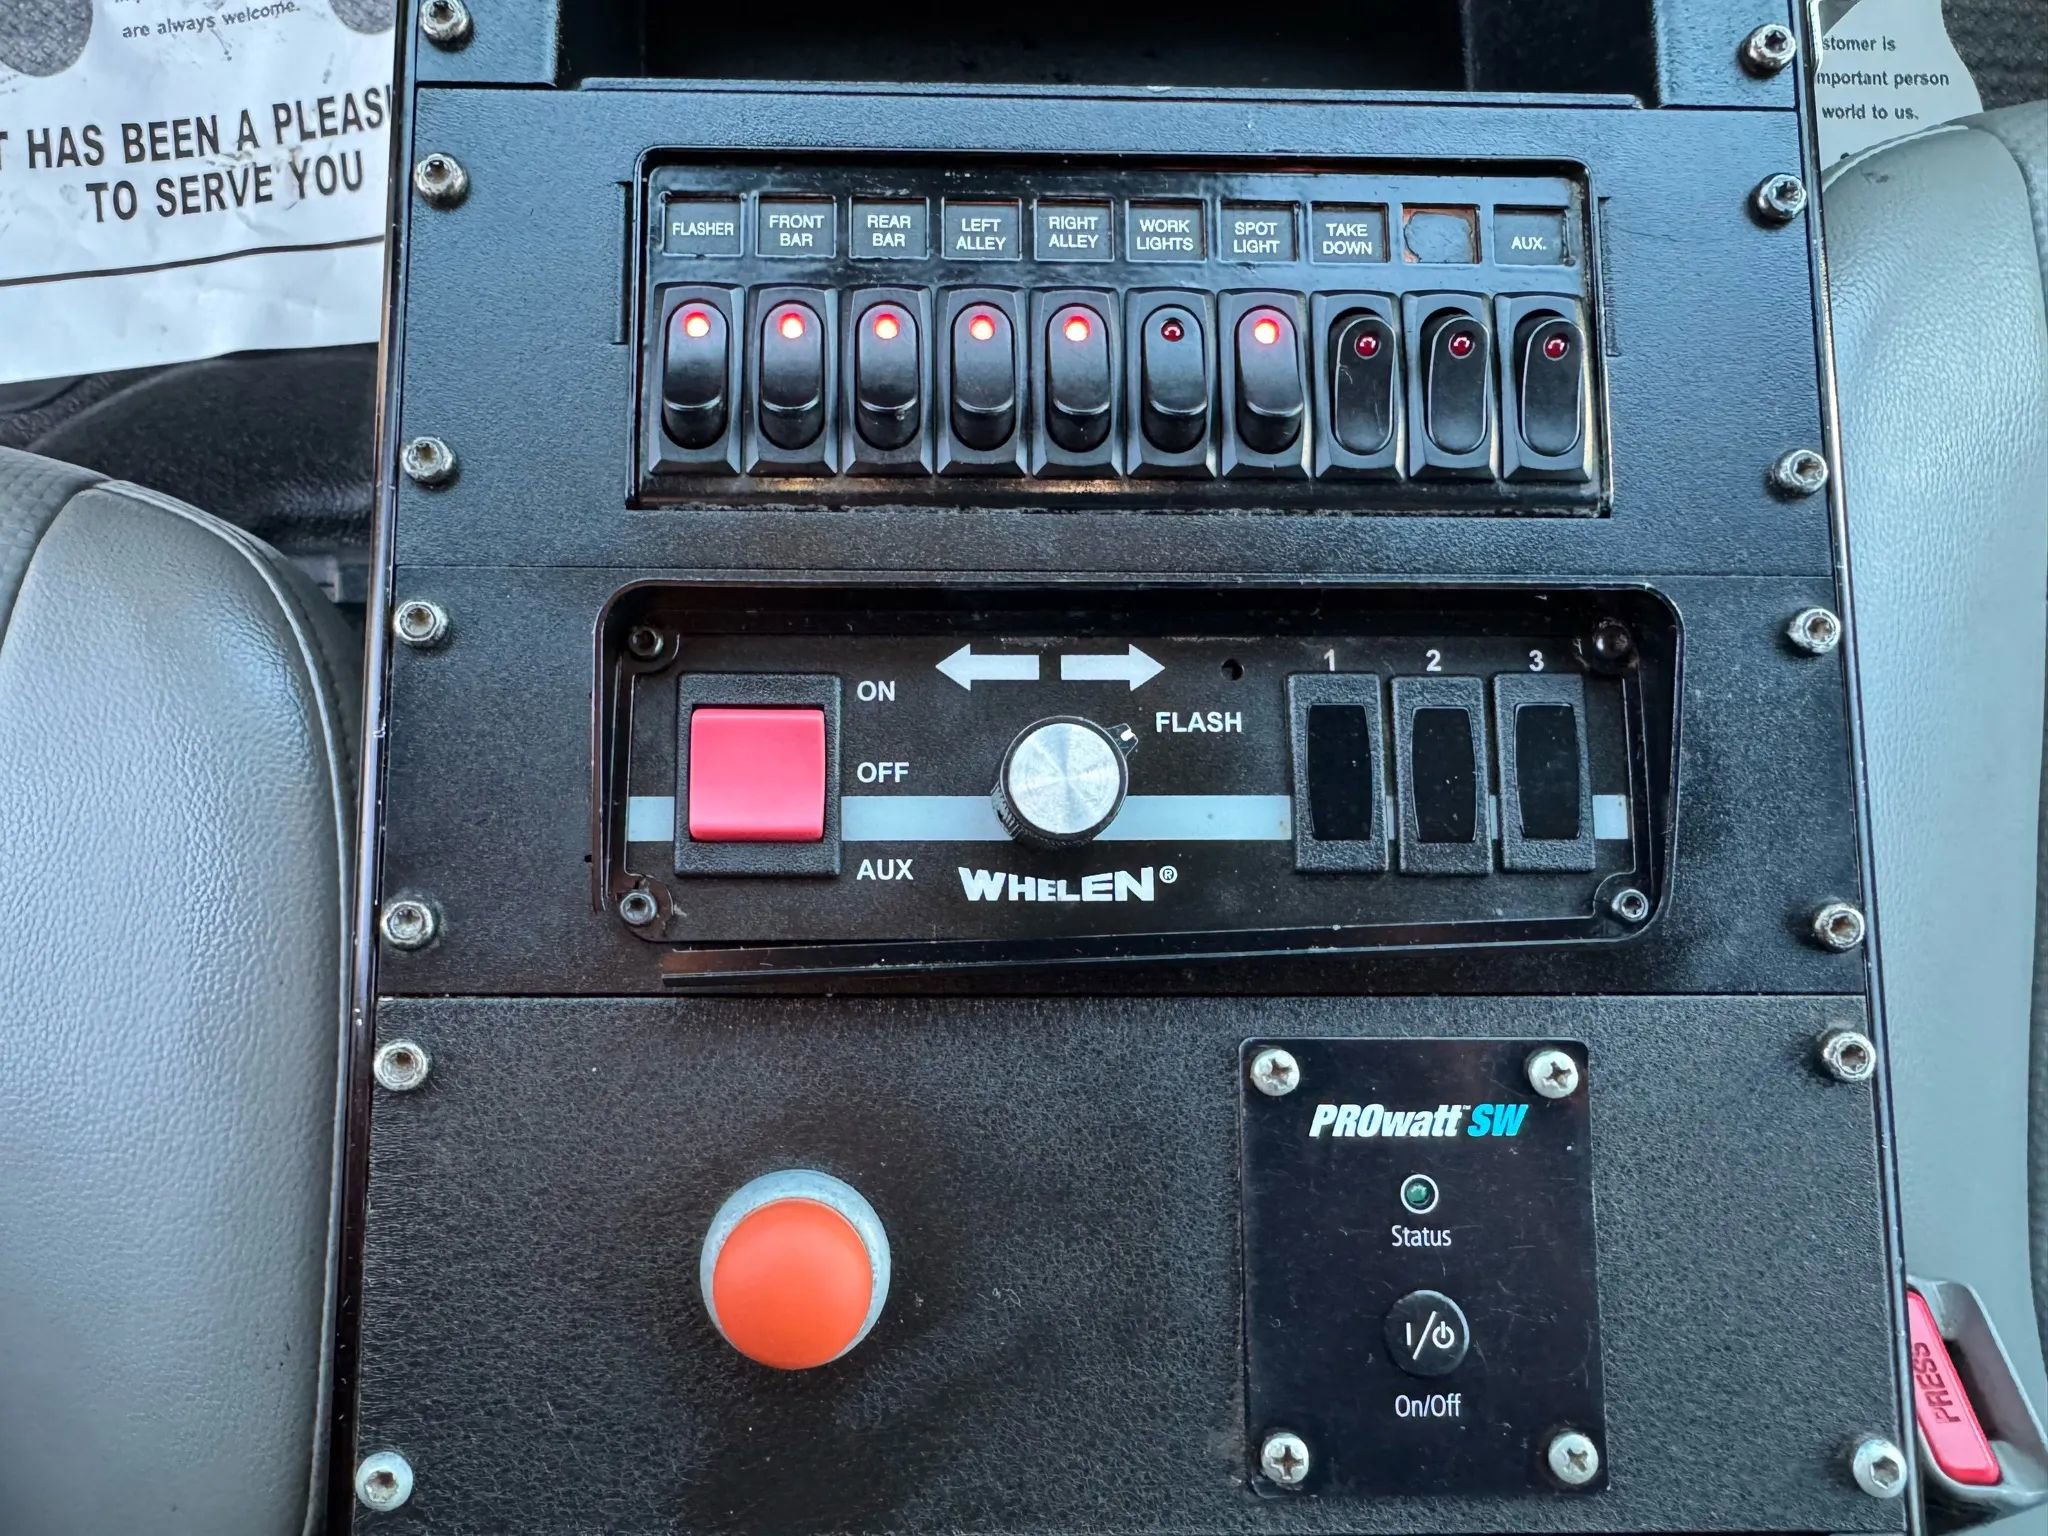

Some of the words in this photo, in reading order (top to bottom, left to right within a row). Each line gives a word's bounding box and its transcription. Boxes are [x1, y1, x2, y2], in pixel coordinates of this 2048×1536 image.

[123, 25, 149, 38] are
[157, 15, 216, 33] always
[222, 1, 300, 25] welcome.
[1883, 36, 1896, 51] is
[1894, 74, 1949, 89] person
[1822, 104, 1865, 119] world
[1872, 104, 1888, 119] to
[27, 125, 104, 168] HAS
[121, 115, 220, 163] BEEN
[237, 109, 260, 151] A
[273, 84, 391, 144] PLEAS
[86, 181, 137, 222] TO
[155, 165, 273, 217] SERVE
[288, 149, 362, 199] YOU
[673, 222, 733, 235] FLASHER
[770, 215, 824, 228] FRONT
[868, 215, 911, 228] REAR
[962, 218, 1001, 232] LEFT
[1049, 216, 1098, 230] RIGHT
[1140, 219, 1190, 232] WORK
[1235, 221, 1278, 235] SPOT
[1326, 223, 1368, 236] TAKE
[780, 233, 812, 246] BAR
[873, 233, 905, 246] BAR
[956, 236, 1006, 250] ALLEY
[1049, 234, 1098, 248] ALLEY
[1137, 237, 1193, 251] LIGHTS
[1234, 240, 1280, 253] LIGHT
[1511, 236, 1546, 250] AUX.
[1323, 241, 1372, 254] DOWN
[1324, 649, 1335, 671] 1
[1426, 650, 1441, 671] 2
[1530, 650, 1544, 671] 3
[857, 681, 895, 701] ON
[1156, 712, 1242, 732] FLASH
[857, 762, 909, 783] OFF
[857, 859, 913, 880] AUX
[1467, 1103, 1529, 1137] SW
[1392, 1225, 1451, 1247] Status
[1912, 1342, 1962, 1424] PRESS
[1395, 1393, 1461, 1417] On/Off
